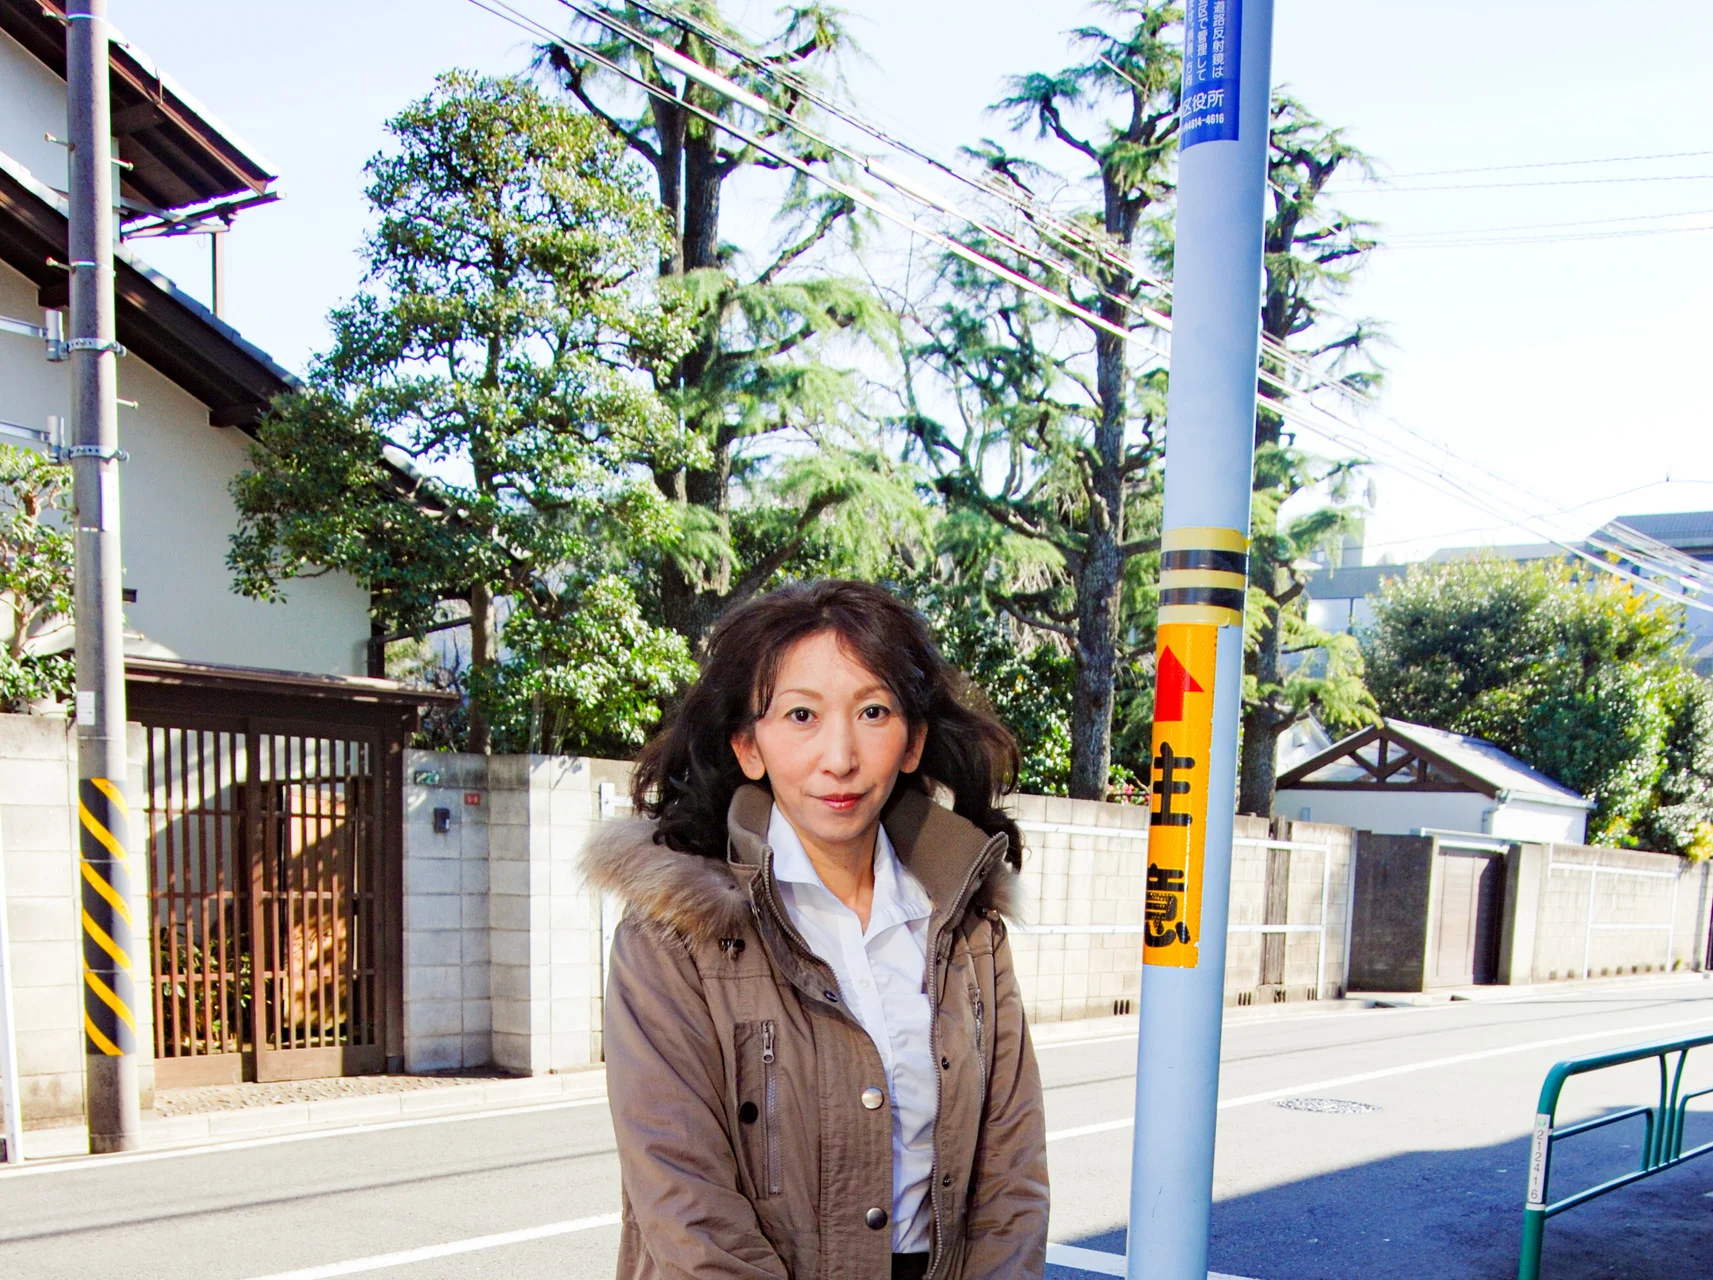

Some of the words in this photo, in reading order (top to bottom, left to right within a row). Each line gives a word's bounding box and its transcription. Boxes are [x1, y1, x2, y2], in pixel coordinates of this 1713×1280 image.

[1197, 0, 1208, 81] 区で管理して
[1530, 1129, 1545, 1200] 212416
